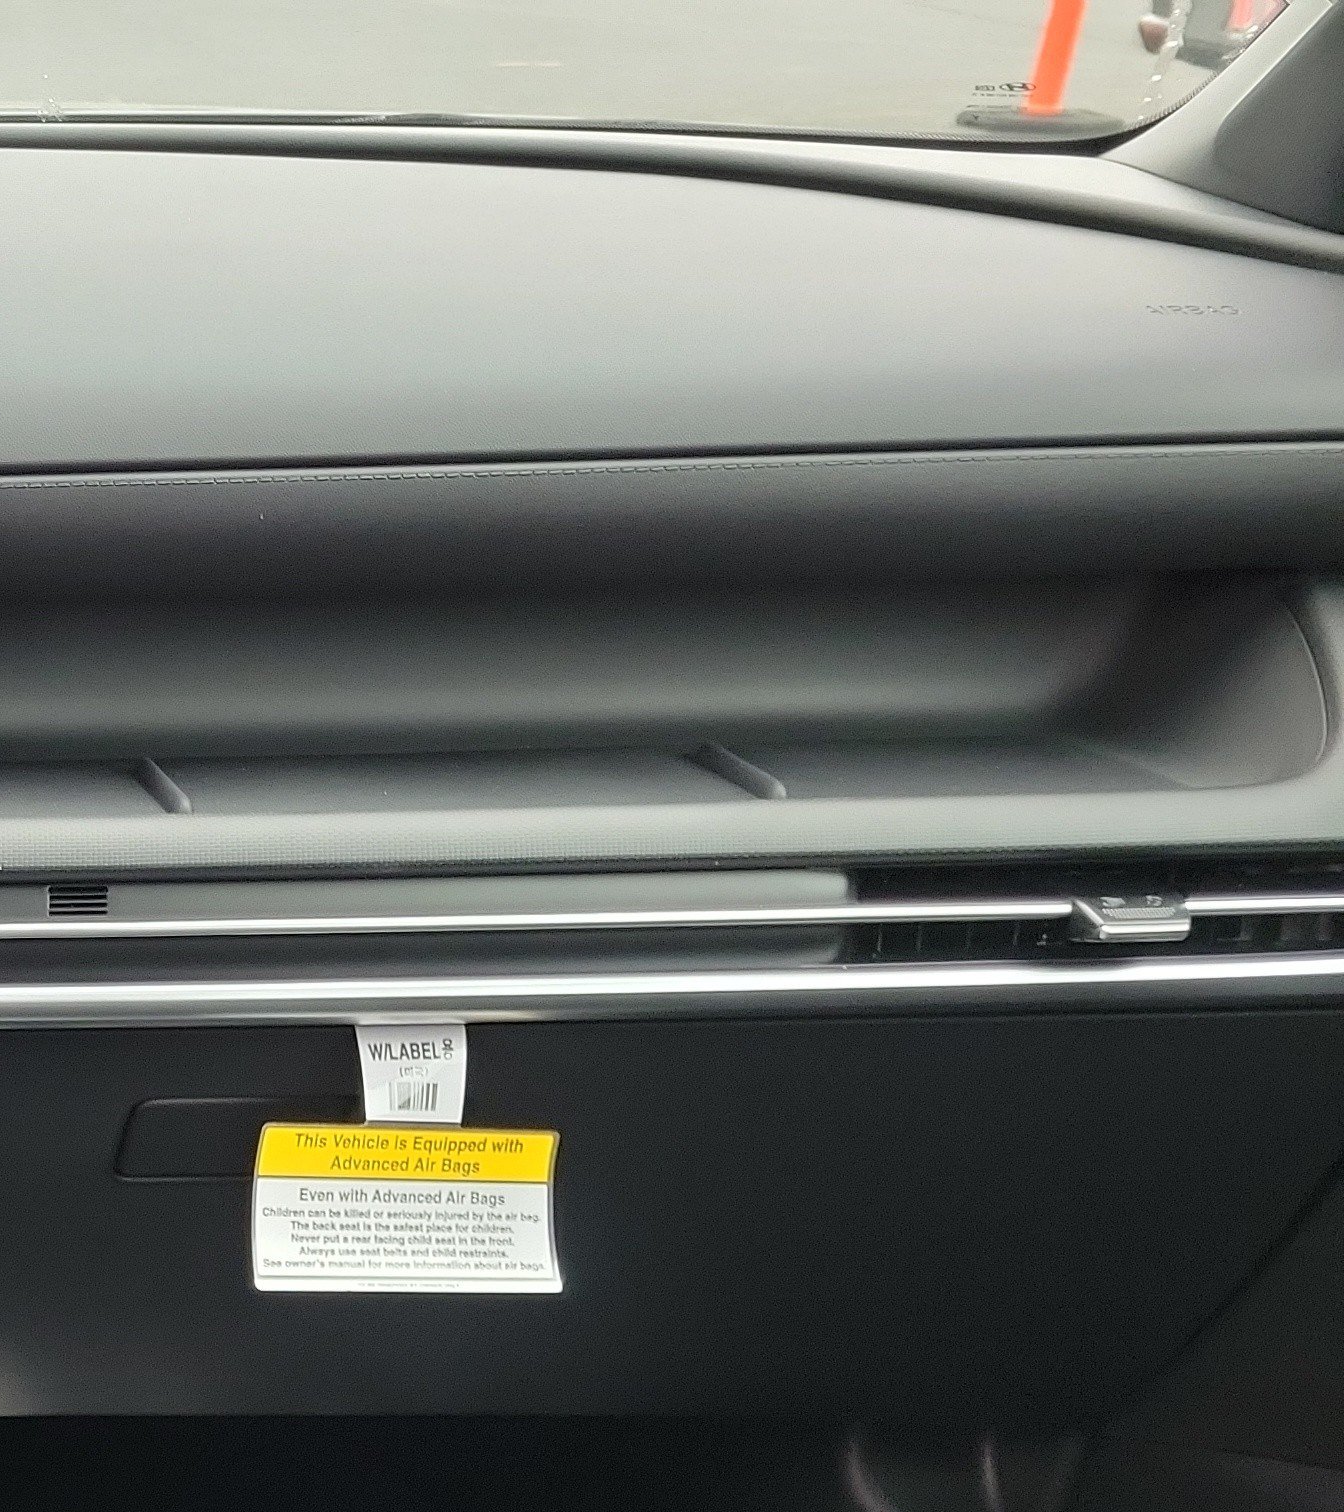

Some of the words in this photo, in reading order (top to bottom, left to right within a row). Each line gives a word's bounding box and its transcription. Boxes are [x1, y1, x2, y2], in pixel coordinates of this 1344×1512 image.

[296, 1133, 327, 1148] This
[334, 1134, 389, 1149] Vehicle
[413, 1136, 487, 1155] Equipped
[492, 1138, 523, 1154] with
[330, 1156, 409, 1171] Advanced
[413, 1157, 436, 1172] Air
[442, 1158, 480, 1177] Bags
[299, 1187, 334, 1202] Even
[339, 1188, 367, 1203] with
[371, 1189, 441, 1204] Advanced
[445, 1190, 466, 1204] Air
[471, 1191, 506, 1208] Bags
[263, 1207, 305, 1217] Children
[308, 1209, 326, 1218] can
[329, 1208, 340, 1218] be
[344, 1208, 370, 1219] killed
[373, 1210, 383, 1219] or
[387, 1210, 432, 1221] seriously
[435, 1210, 469, 1222] injured
[472, 1211, 484, 1222] by
[487, 1211, 502, 1221] the
[291, 1221, 309, 1230] The
[312, 1221, 336, 1231] back
[339, 1222, 360, 1231] seat
[375, 1222, 390, 1232] the
[394, 1223, 424, 1232] safest
[426, 1223, 452, 1234] place
[455, 1224, 468, 1233] for
[472, 1224, 514, 1234] children.
[291, 1233, 320, 1243] Never
[323, 1234, 339, 1245] put
[351, 1235, 371, 1243] rear
[374, 1234, 405, 1246] facing
[408, 1235, 432, 1245] child
[435, 1236, 456, 1245] seat
[458, 1236, 468, 1245] in
[471, 1236, 486, 1246] the
[300, 1246, 336, 1257] Always
[339, 1248, 356, 1256] use
[360, 1247, 380, 1256] seat
[383, 1247, 407, 1256] belts
[411, 1247, 429, 1256] and
[432, 1248, 456, 1257] child
[263, 1258, 282, 1267] See
[285, 1259, 325, 1268] owner's
[328, 1259, 365, 1268] manual
[368, 1259, 382, 1268] for
[385, 1260, 410, 1269] more
[413, 1260, 471, 1269] information
[474, 1261, 502, 1270] about
